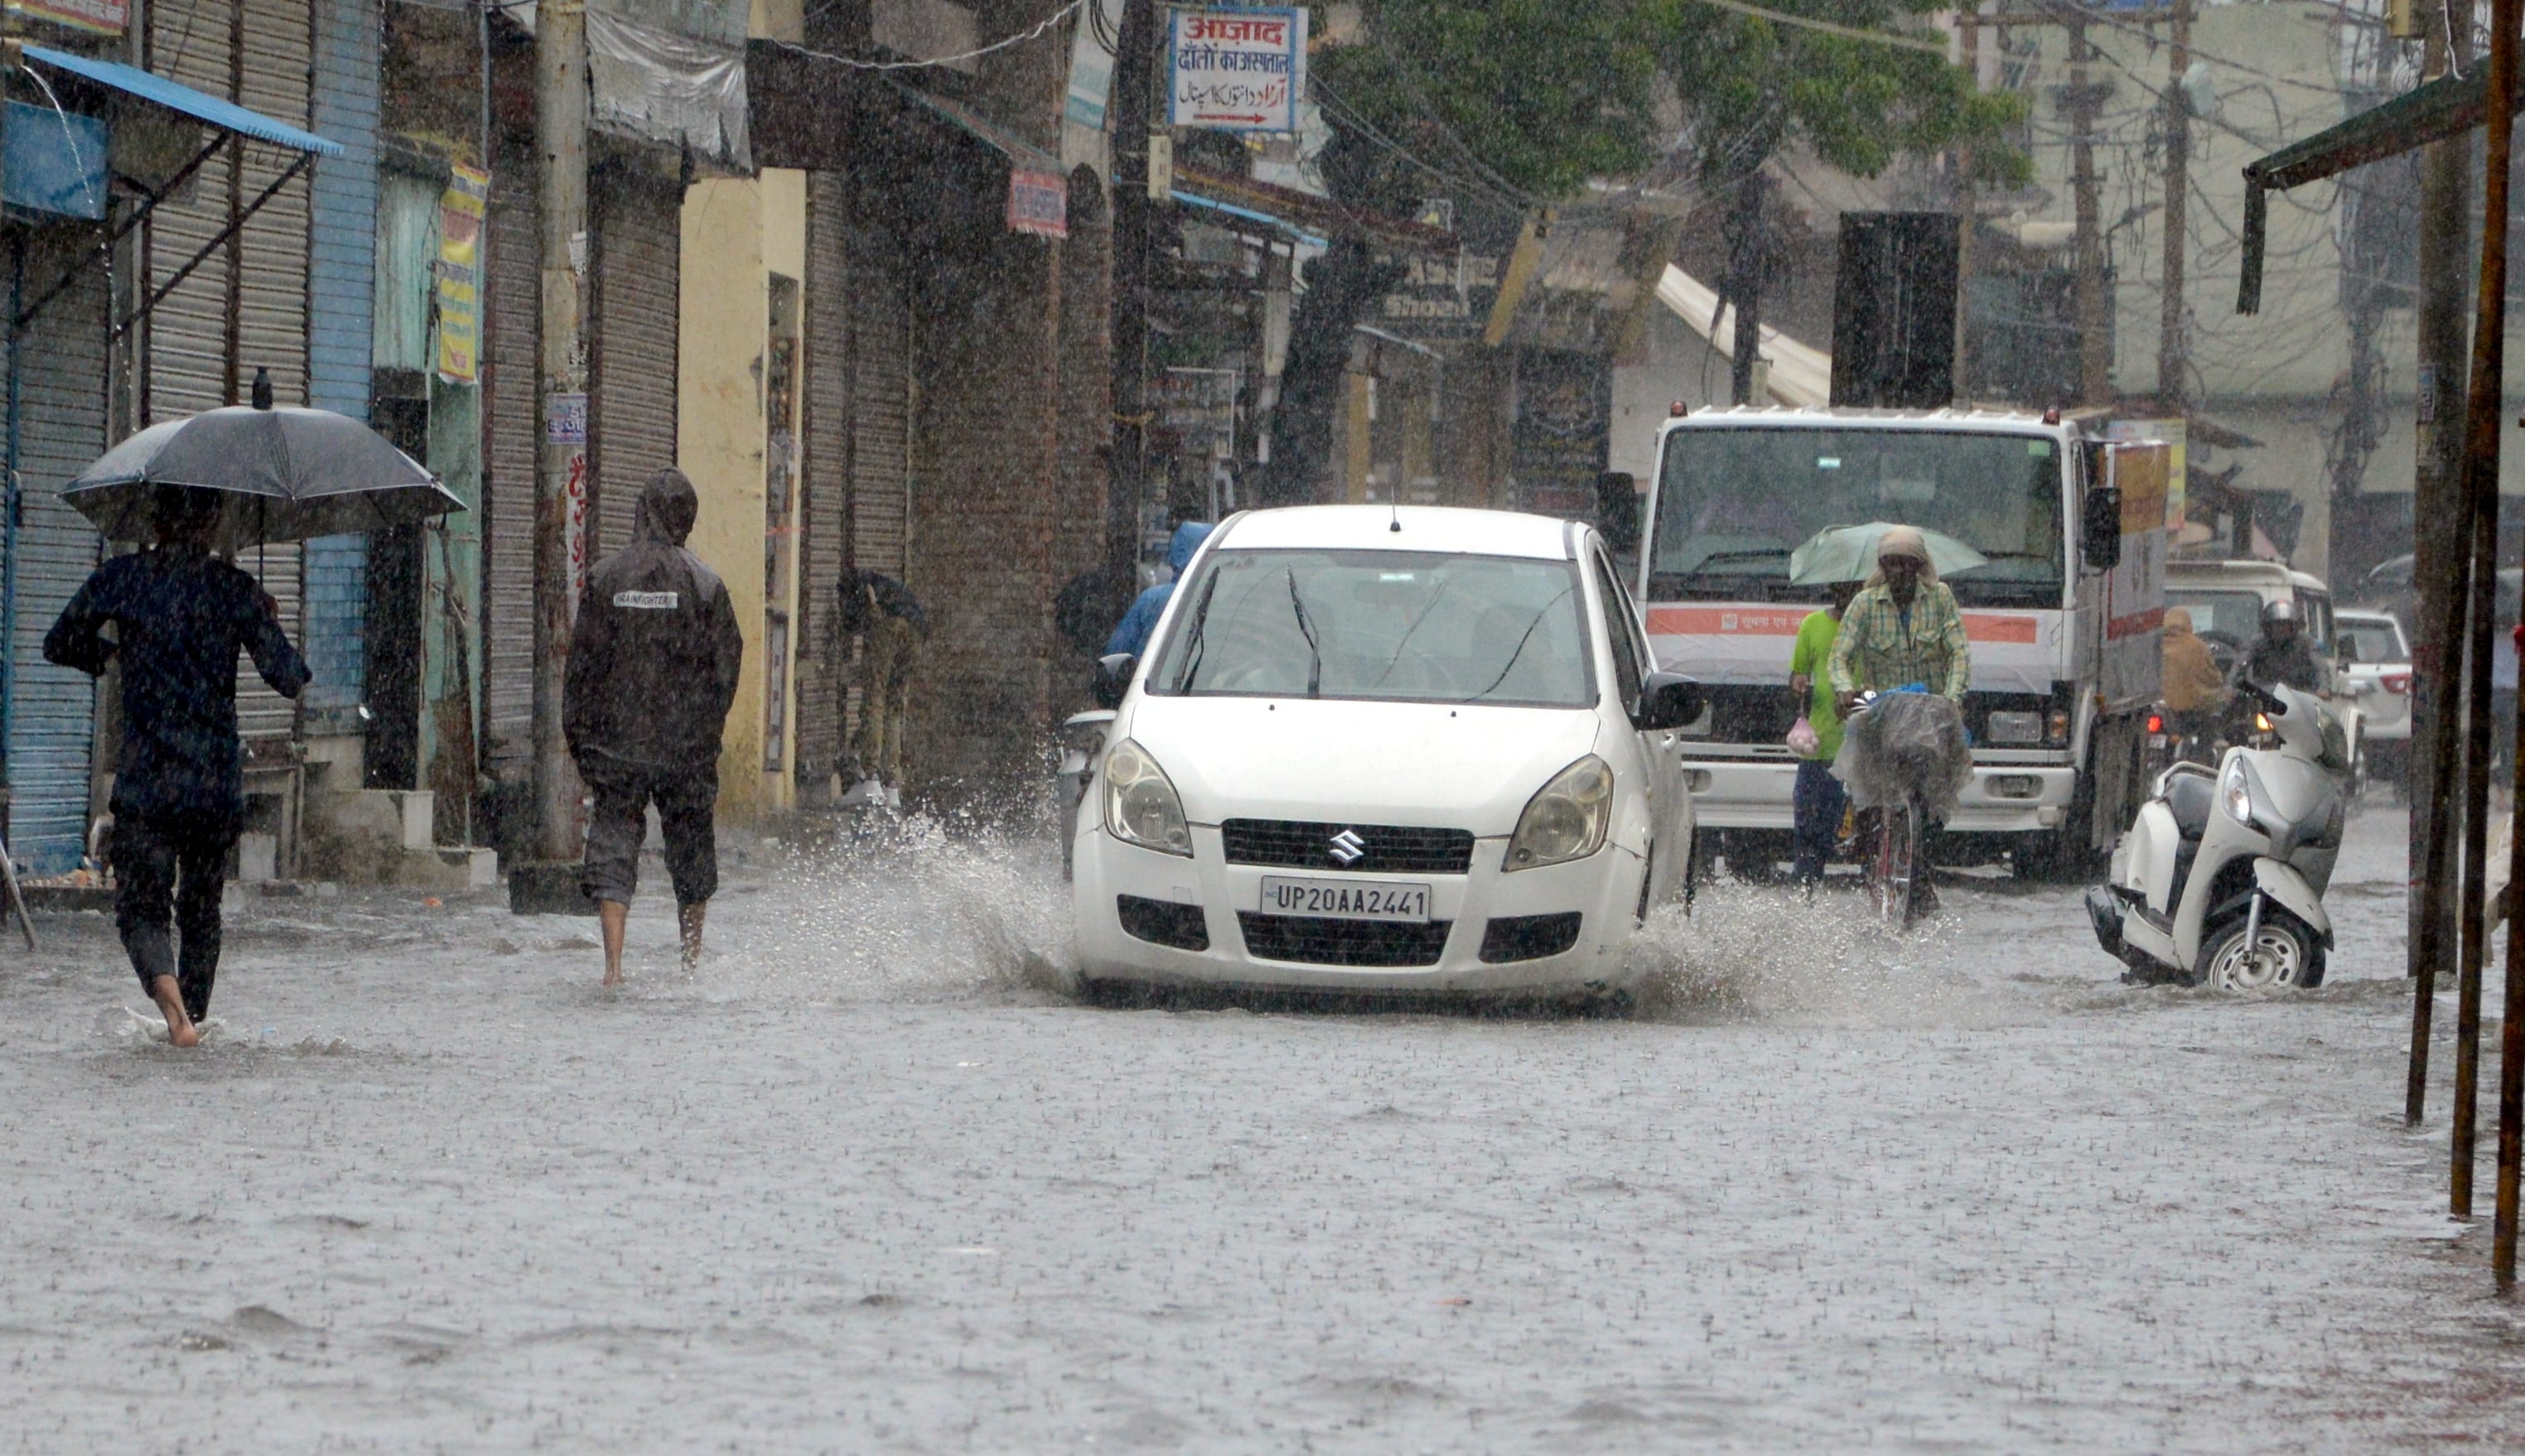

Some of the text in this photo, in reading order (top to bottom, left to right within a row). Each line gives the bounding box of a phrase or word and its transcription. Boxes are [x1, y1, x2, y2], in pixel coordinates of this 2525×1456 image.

[1185, 17, 1286, 45] आज़ाद
[1219, 50, 1238, 72] का
[1238, 51, 1288, 74] अस्पताल
[1257, 78, 1286, 108] آزاد
[1277, 885, 1425, 915] UP20AA2441
